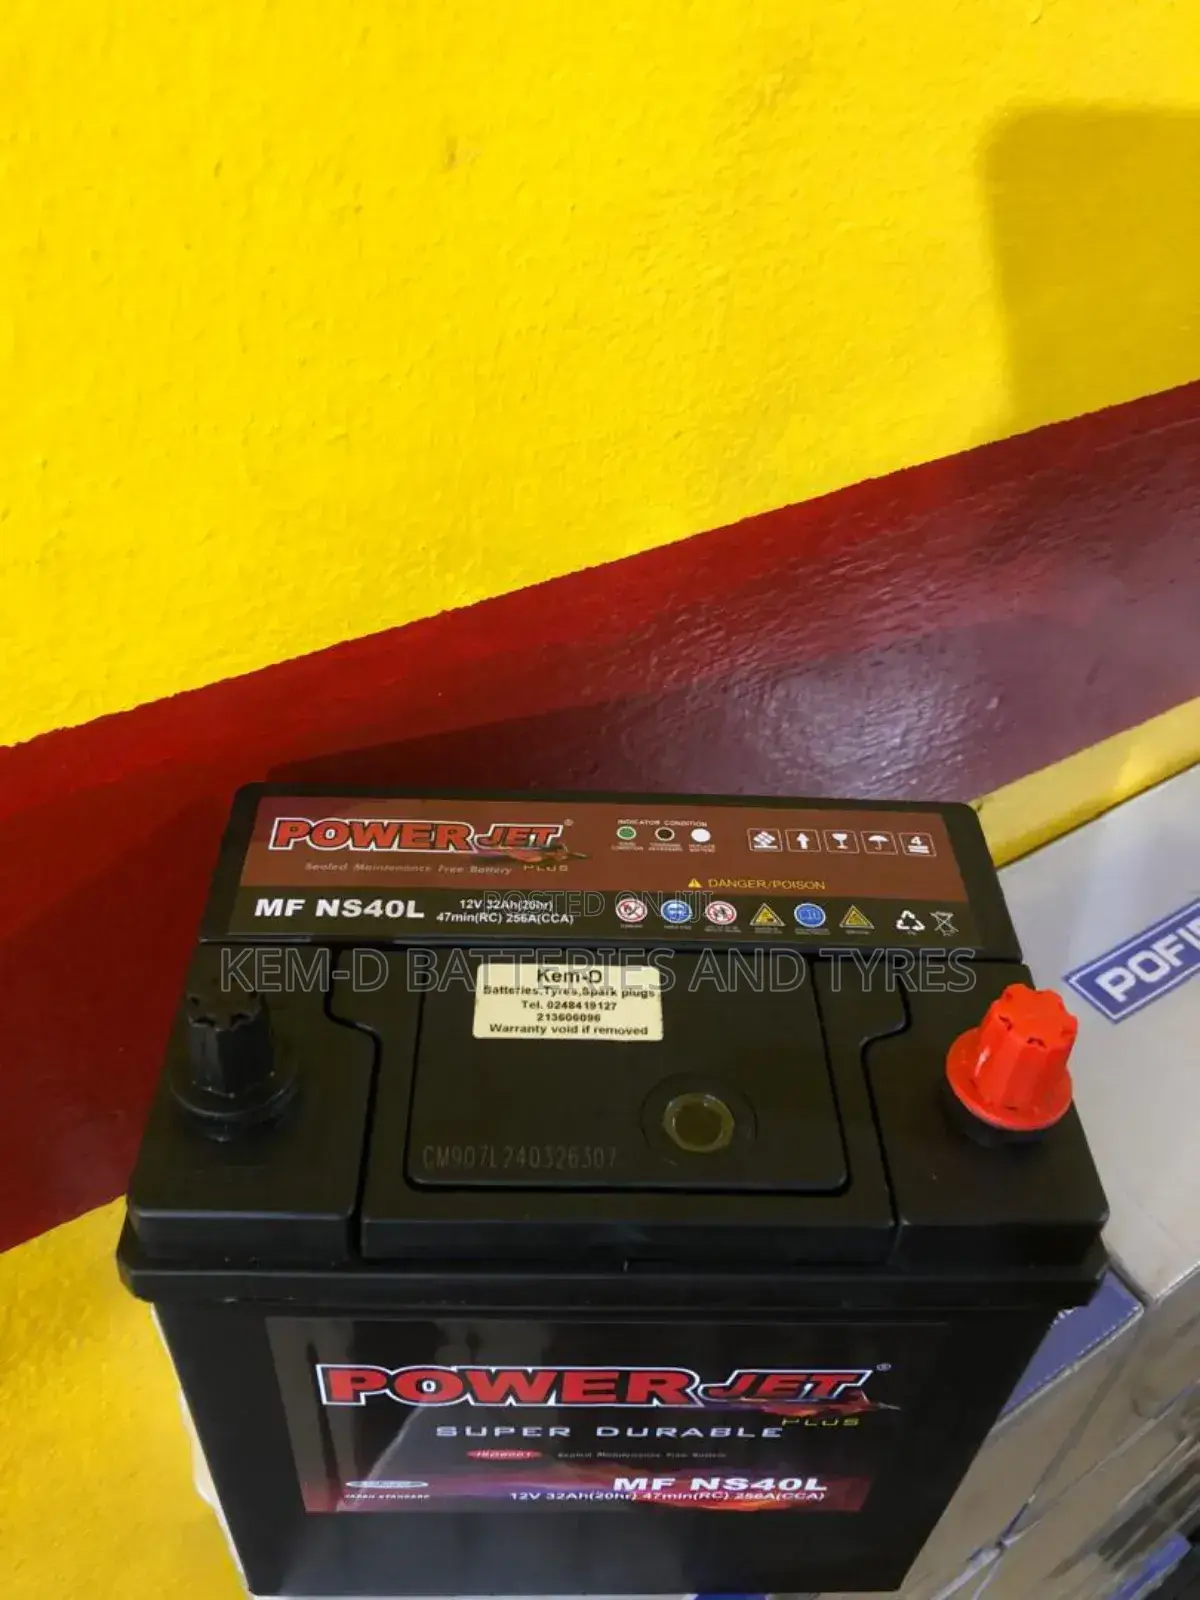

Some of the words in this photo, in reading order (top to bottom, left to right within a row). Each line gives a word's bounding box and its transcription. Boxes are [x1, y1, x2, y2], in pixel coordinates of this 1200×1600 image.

[268, 817, 478, 853] POWER
[474, 823, 563, 850] JET
[305, 862, 349, 871] Sealed
[470, 865, 513, 876] Battery
[708, 879, 826, 890] DANGER/POISON
[254, 898, 306, 917] MF
[315, 898, 426, 918] NS40L
[459, 899, 482, 910] 12V
[436, 912, 503, 925] 47min(RC)
[505, 913, 575, 926] 256A(CCA)
[536, 969, 603, 984] Kem-D
[520, 1000, 544, 1010] Tel.
[546, 1001, 618, 1011] 0248419127
[489, 1023, 548, 1035] Warranty
[551, 1024, 579, 1034] void
[582, 1025, 589, 1034] if
[593, 1025, 649, 1036] removed
[316, 1363, 705, 1407] POWER
[700, 1369, 873, 1402] JET
[435, 1426, 572, 1438] SUPER
[596, 1427, 783, 1439] DURABLE
[613, 1477, 676, 1491] MF
[690, 1477, 828, 1491] NS40L
[509, 1491, 542, 1501] 12V
[645, 1490, 729, 1501] 47min(RC)
